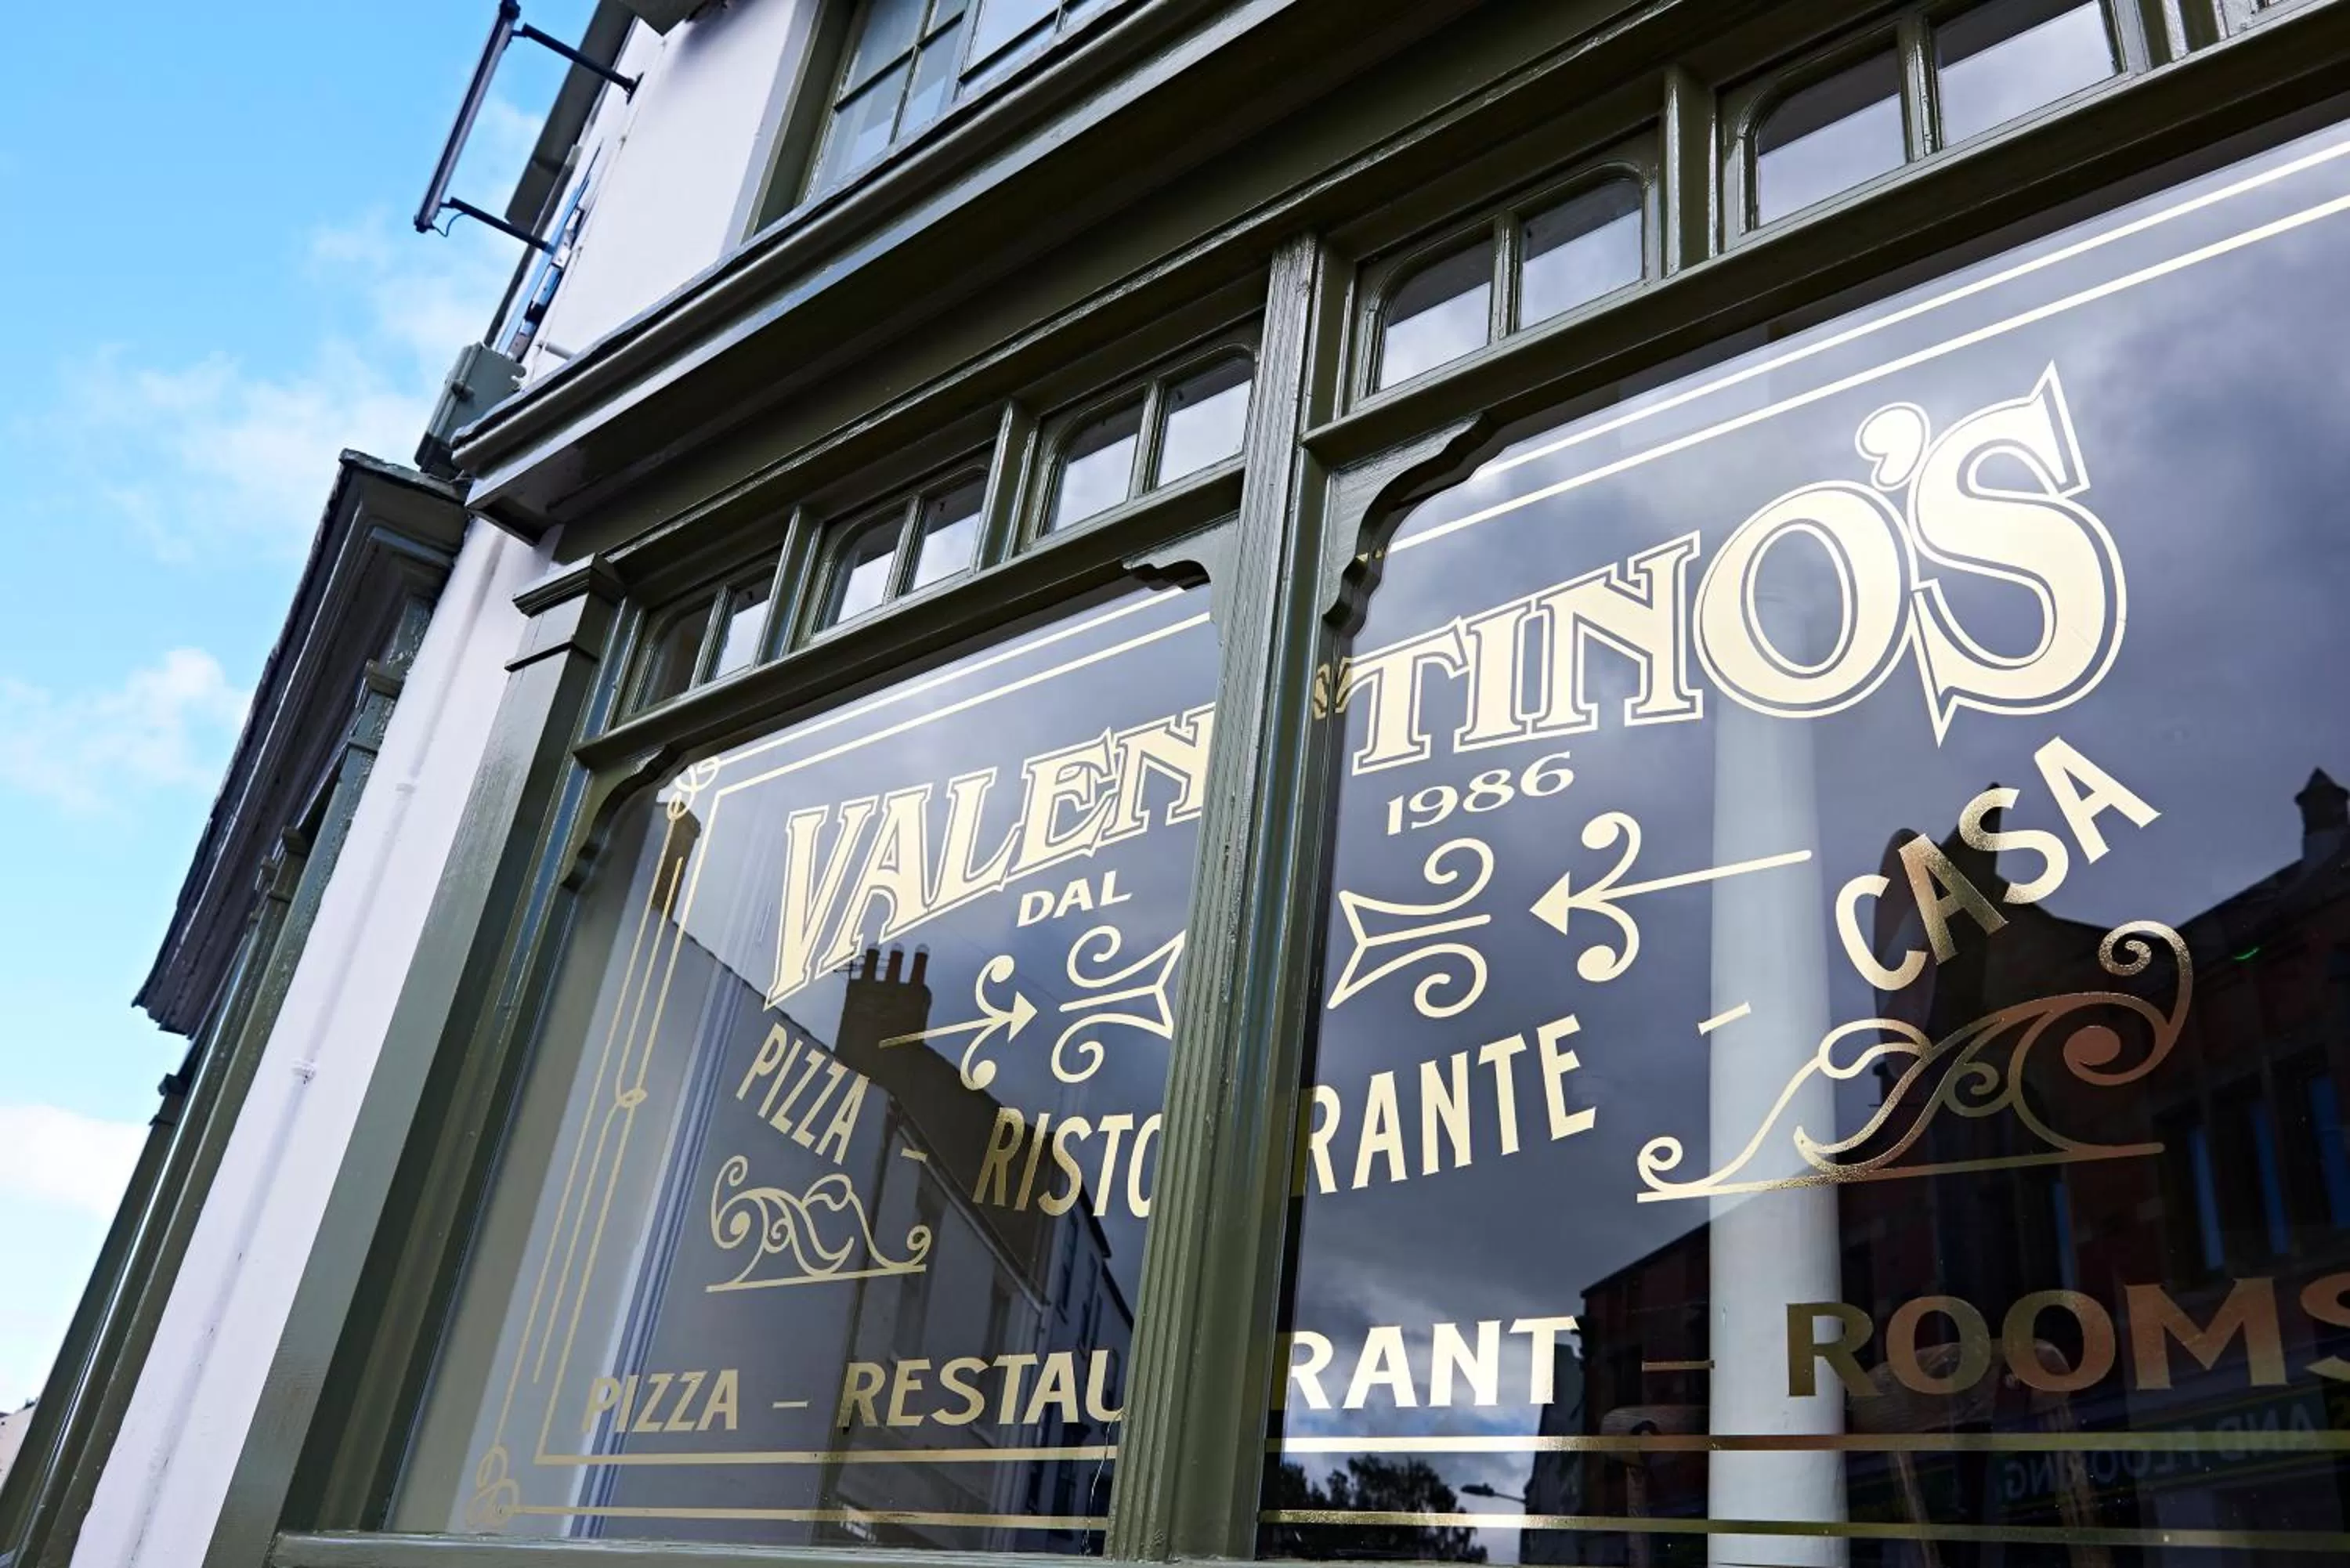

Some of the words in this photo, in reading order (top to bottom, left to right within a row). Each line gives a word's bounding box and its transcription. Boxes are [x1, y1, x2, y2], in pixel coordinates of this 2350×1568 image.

[1016, 871, 1133, 928] DAL
[1385, 751, 1575, 836] 1986
[736, 1021, 870, 1166] PIZZA
[1834, 735, 2161, 992] CASA
[581, 1368, 739, 1433] PIZZA
